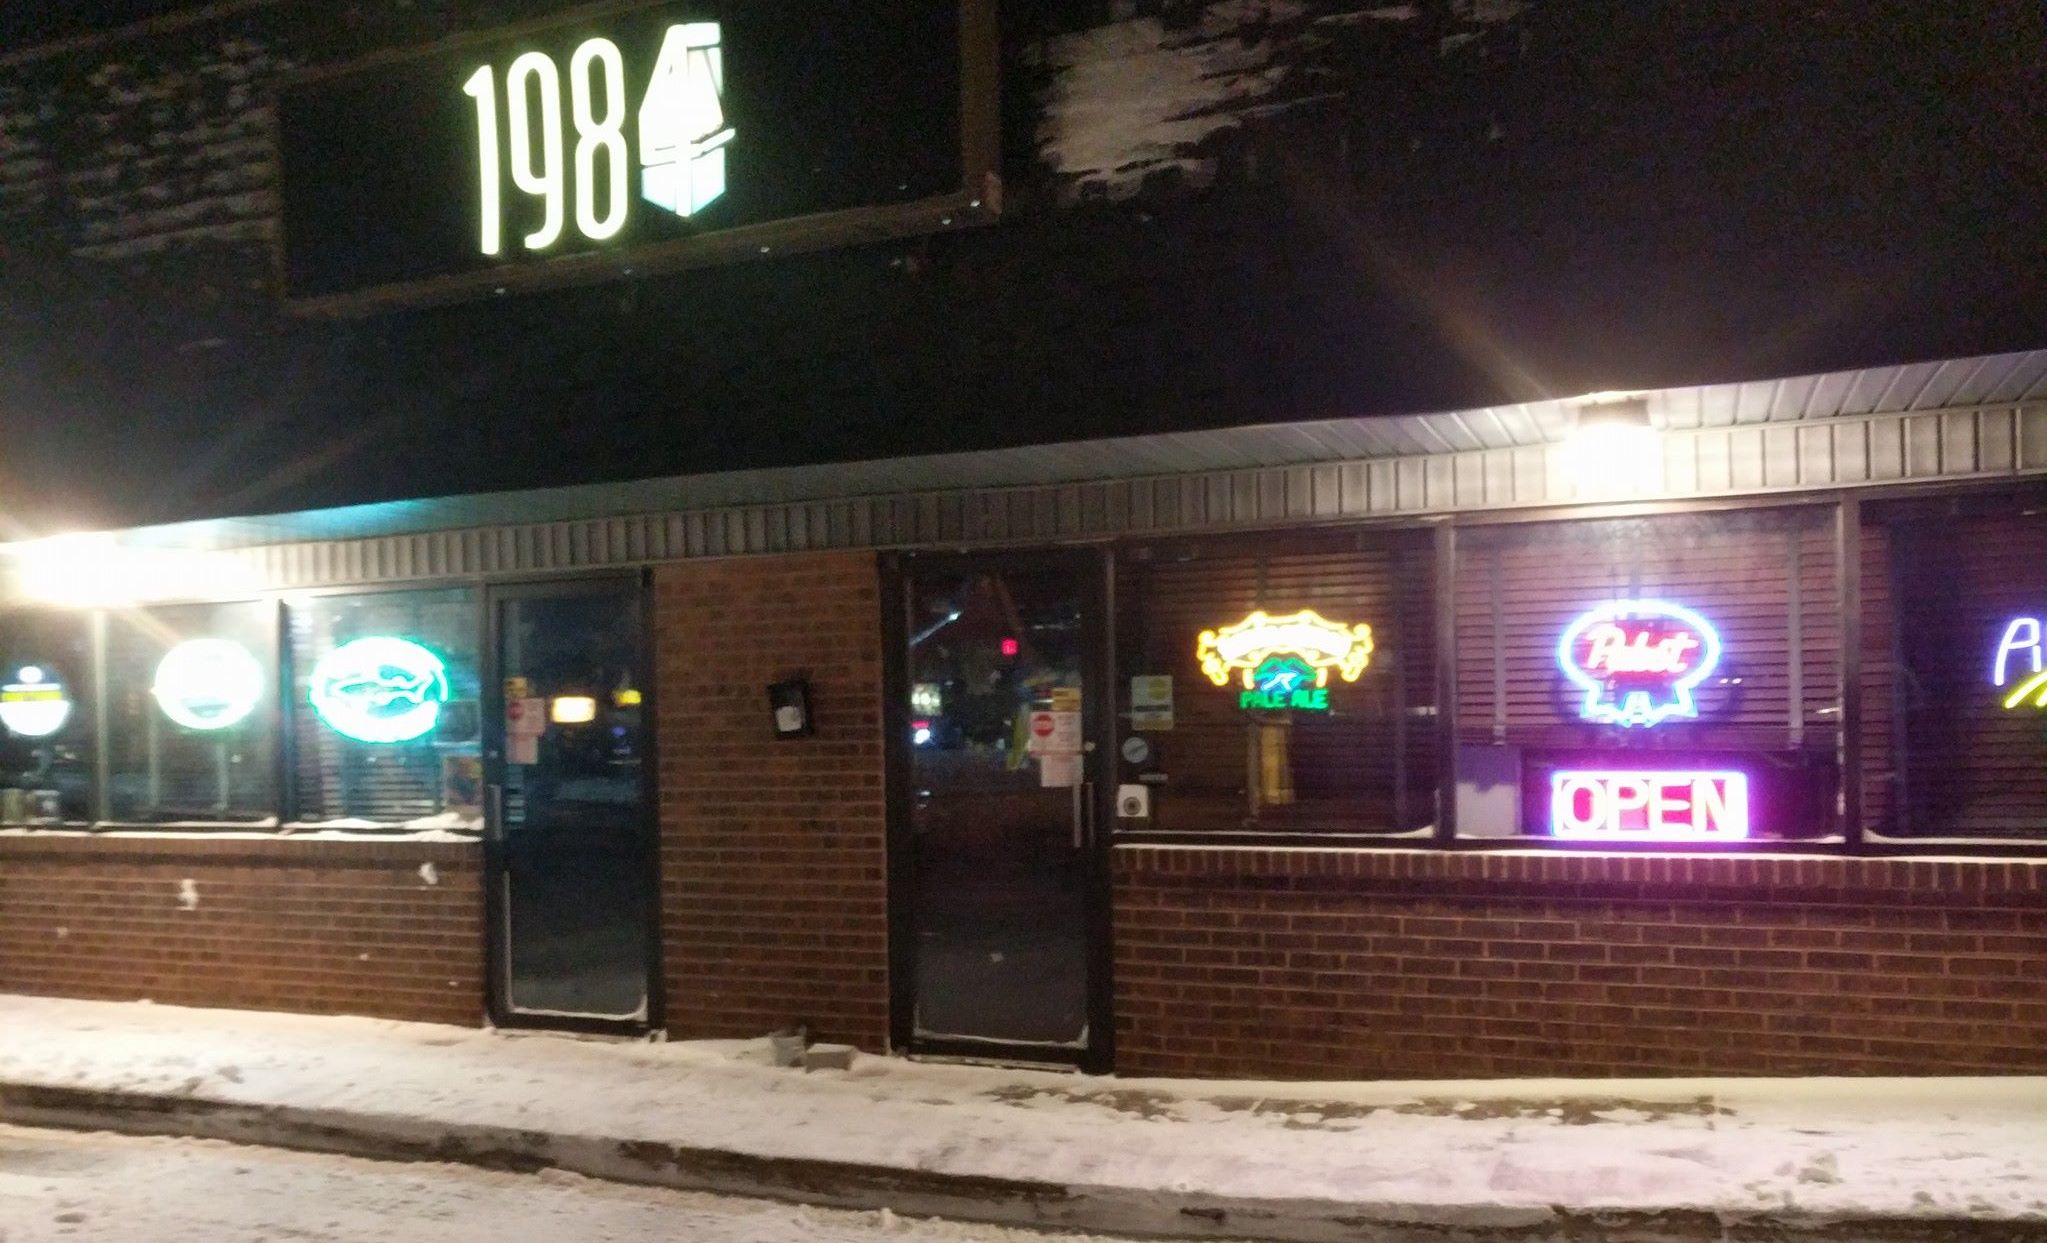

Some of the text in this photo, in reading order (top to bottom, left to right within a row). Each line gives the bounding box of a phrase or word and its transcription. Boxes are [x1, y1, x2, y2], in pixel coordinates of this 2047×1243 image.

[1239, 687, 1329, 710] PALE ALE
[1560, 777, 1736, 833] OPEN
